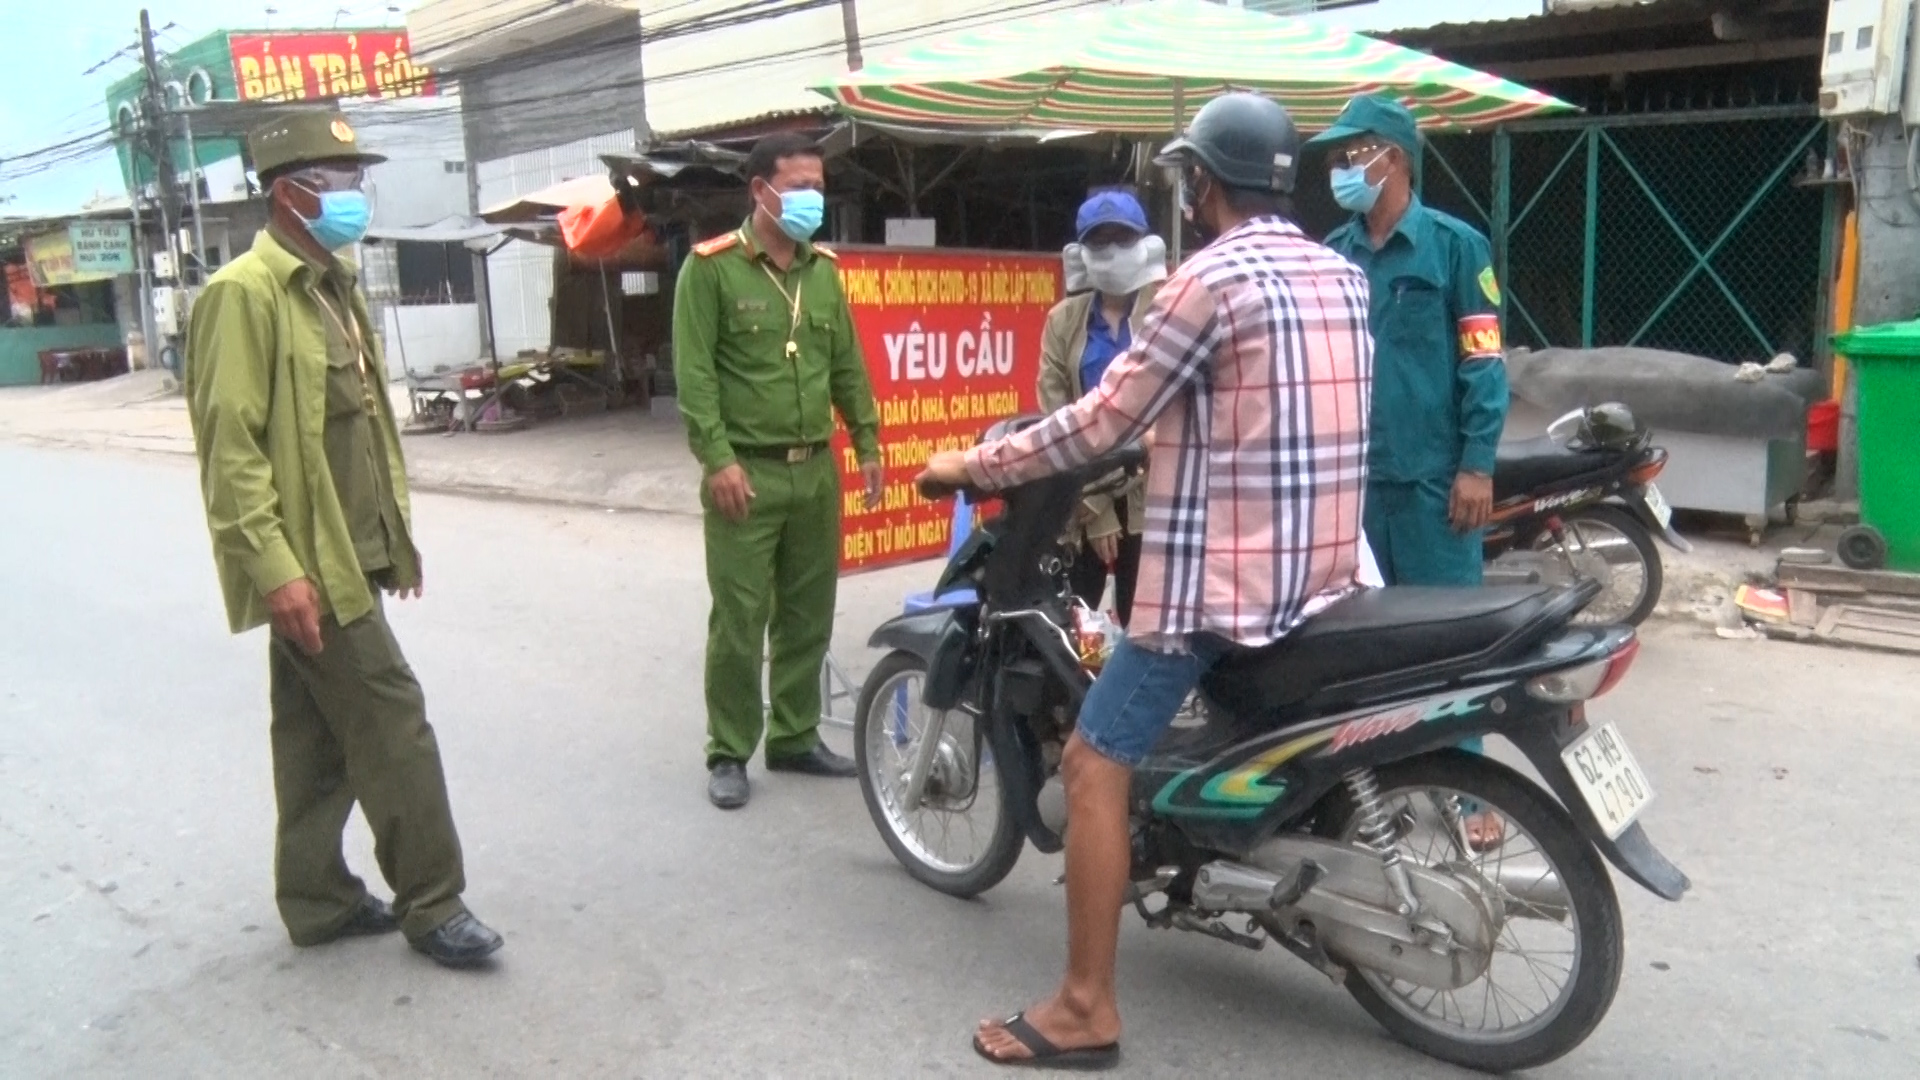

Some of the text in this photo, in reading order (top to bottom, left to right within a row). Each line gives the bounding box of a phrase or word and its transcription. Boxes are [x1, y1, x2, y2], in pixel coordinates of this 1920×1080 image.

[239, 41, 306, 101] BÁN
[308, 34, 368, 97] TRẢ
[939, 268, 978, 305] COVID-19
[882, 310, 1014, 382] YÊU CẦU
[884, 394, 908, 427] DÂN
[911, 389, 920, 424] Ở
[950, 385, 970, 420] CHỈ
[971, 393, 986, 418] RA
[987, 384, 1019, 416] NGOÀI
[887, 433, 934, 468] TRƯỜNG
[884, 479, 909, 511] DÂN
[844, 527, 873, 566] ĐIỆN
[876, 518, 893, 552] TỬ
[894, 513, 916, 550] MỖI
[918, 513, 949, 546] NGÀY
[1598, 767, 1644, 824] 4790
